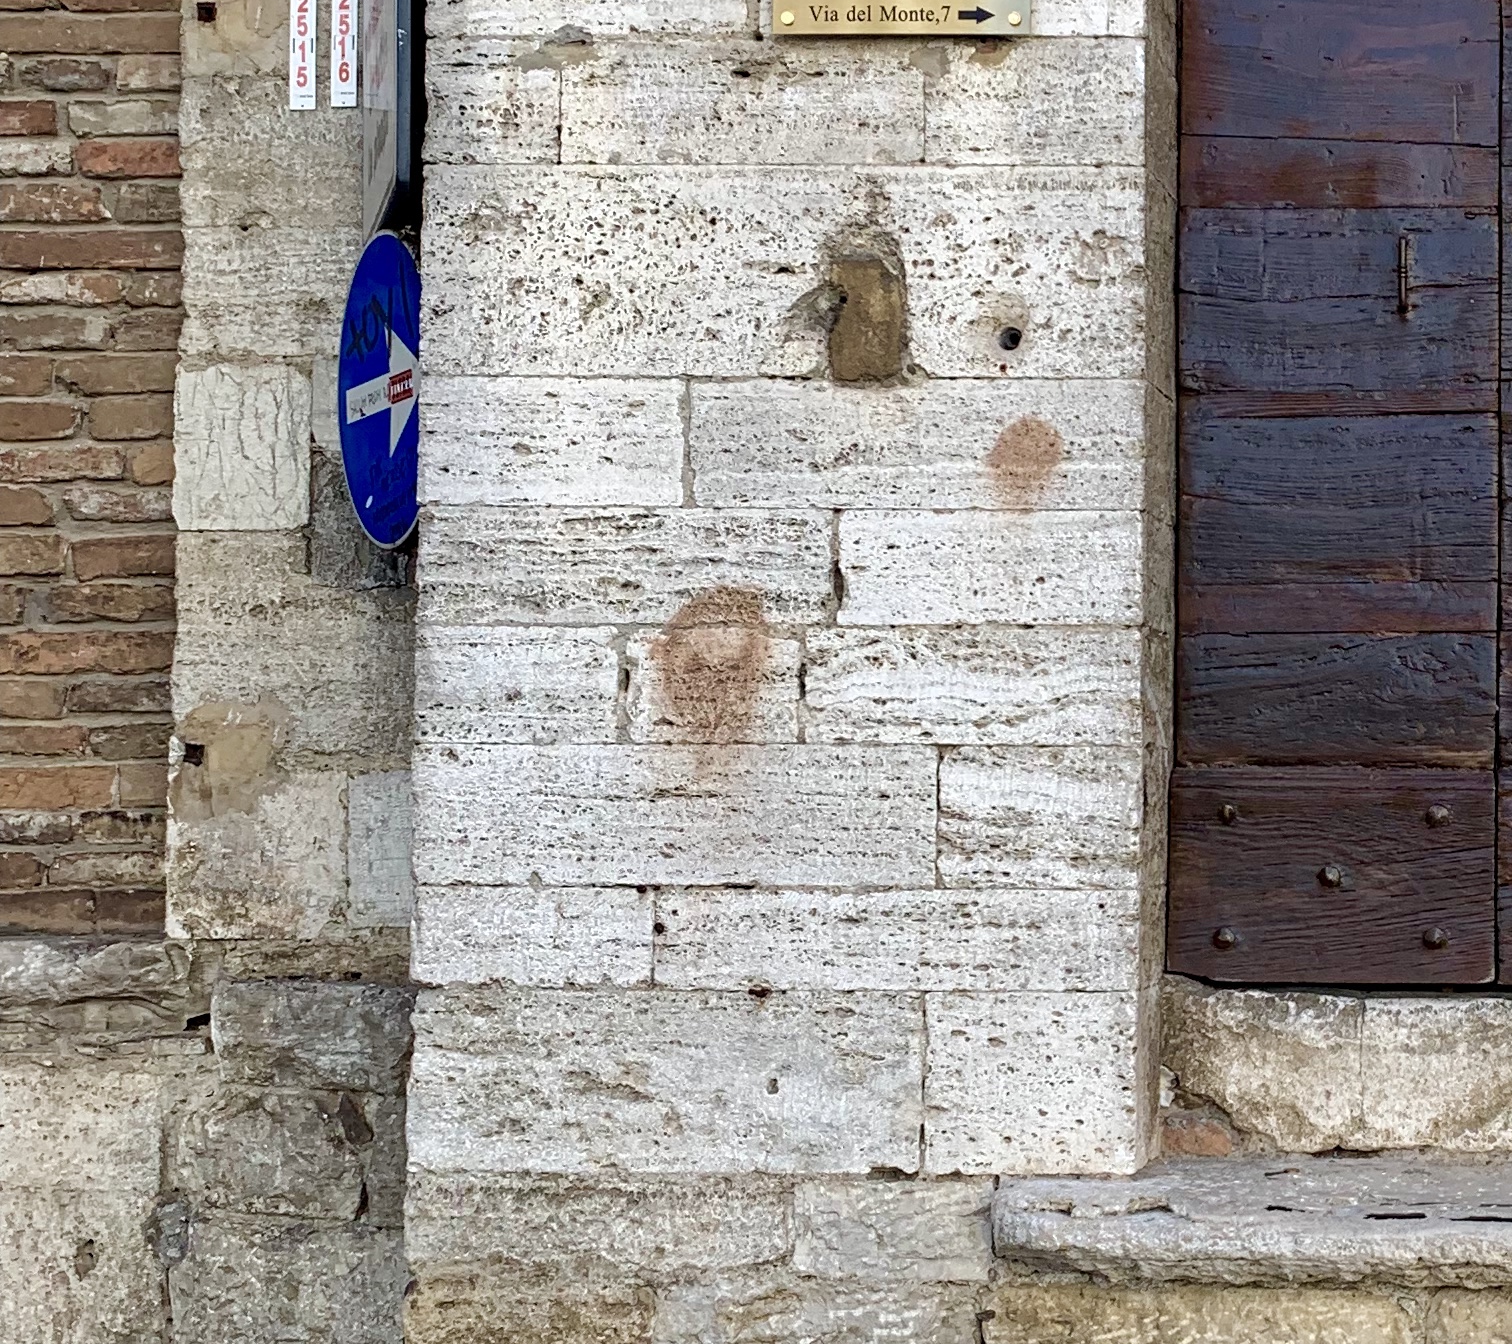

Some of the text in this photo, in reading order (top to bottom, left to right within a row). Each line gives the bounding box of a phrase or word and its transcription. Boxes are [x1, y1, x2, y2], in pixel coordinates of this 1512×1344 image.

[809, 5, 951, 25] Via del Monte,7
